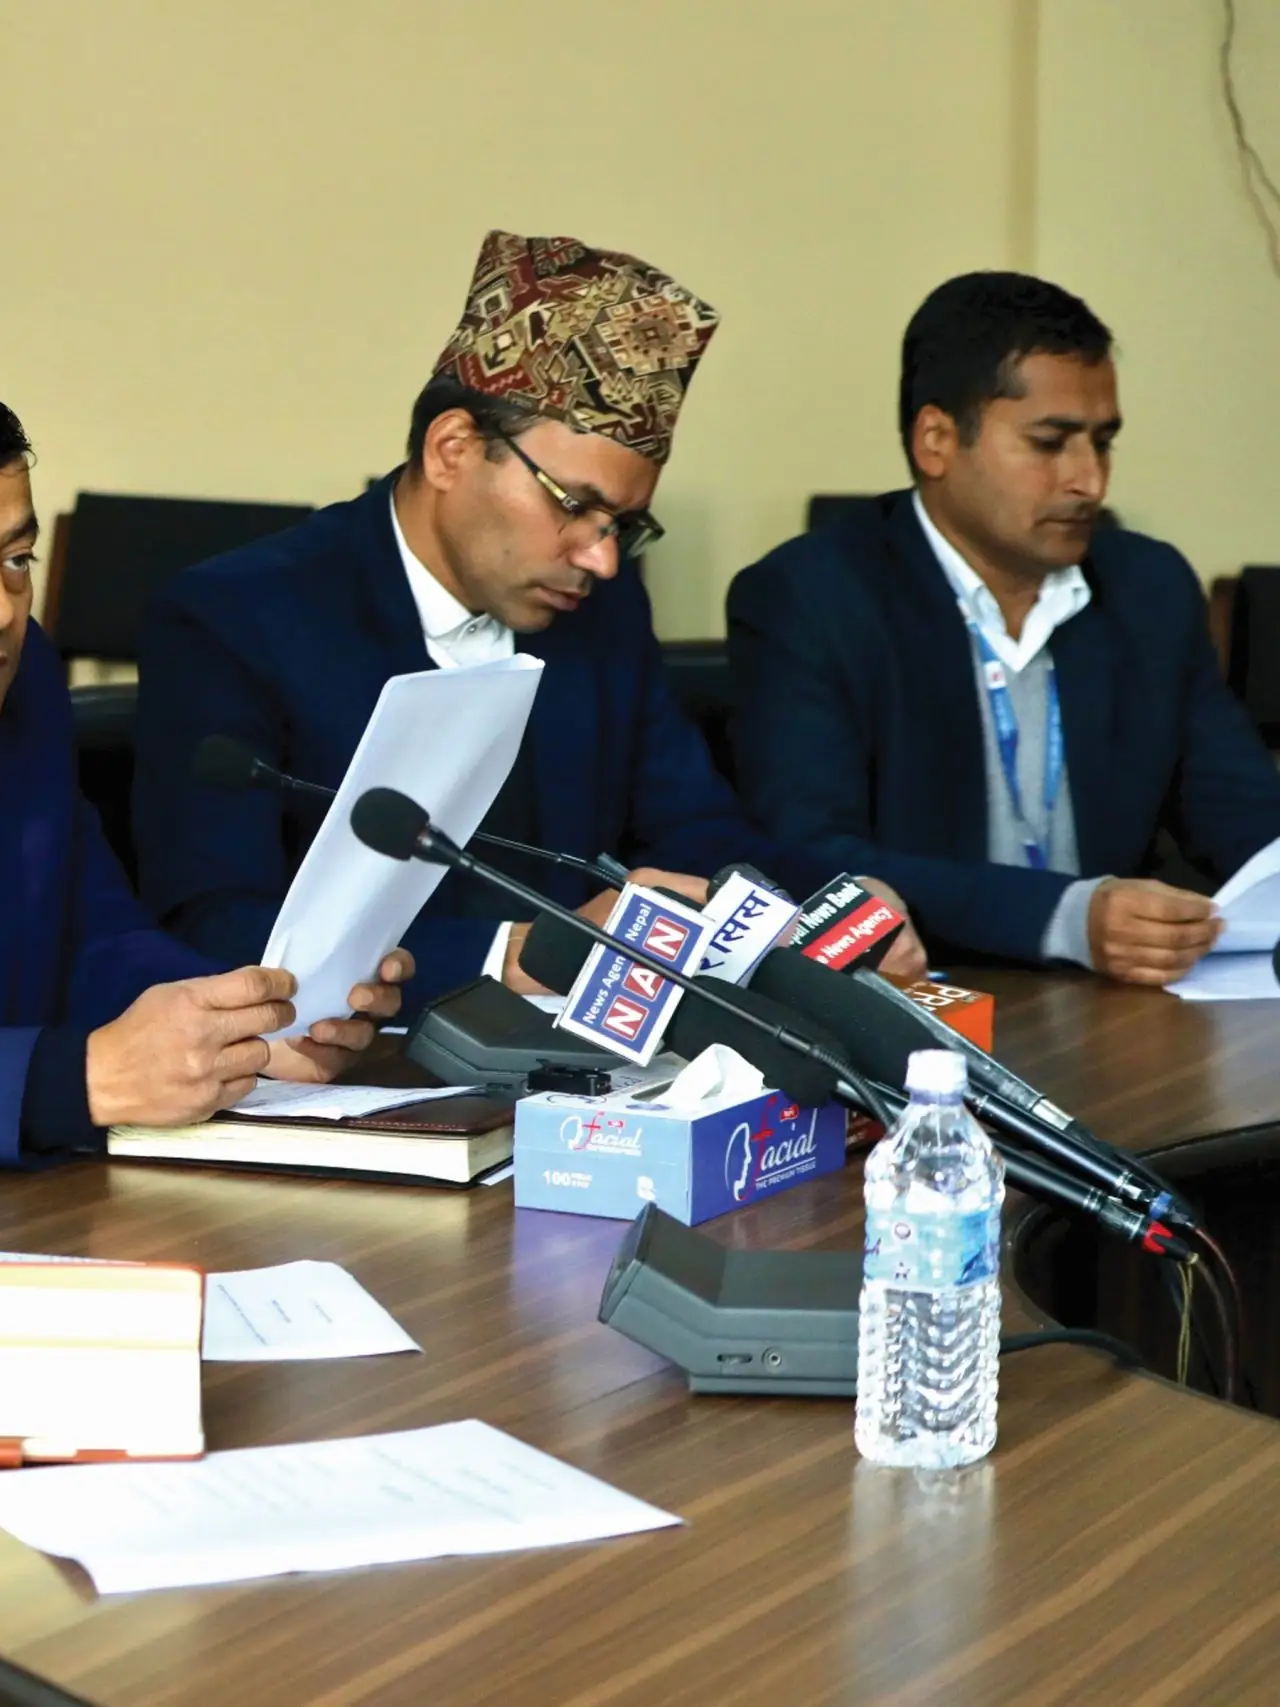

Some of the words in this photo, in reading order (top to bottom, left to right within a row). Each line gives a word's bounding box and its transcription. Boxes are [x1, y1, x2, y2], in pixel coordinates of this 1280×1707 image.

[799, 902, 837, 930] News
[825, 882, 864, 909] Bank
[848, 906, 894, 939] Agency
[582, 989, 609, 1025] News
[602, 955, 627, 989] Agen
[624, 903, 653, 941] Nepal
[912, 983, 972, 1011] PR
[543, 1169, 571, 1187] 100
